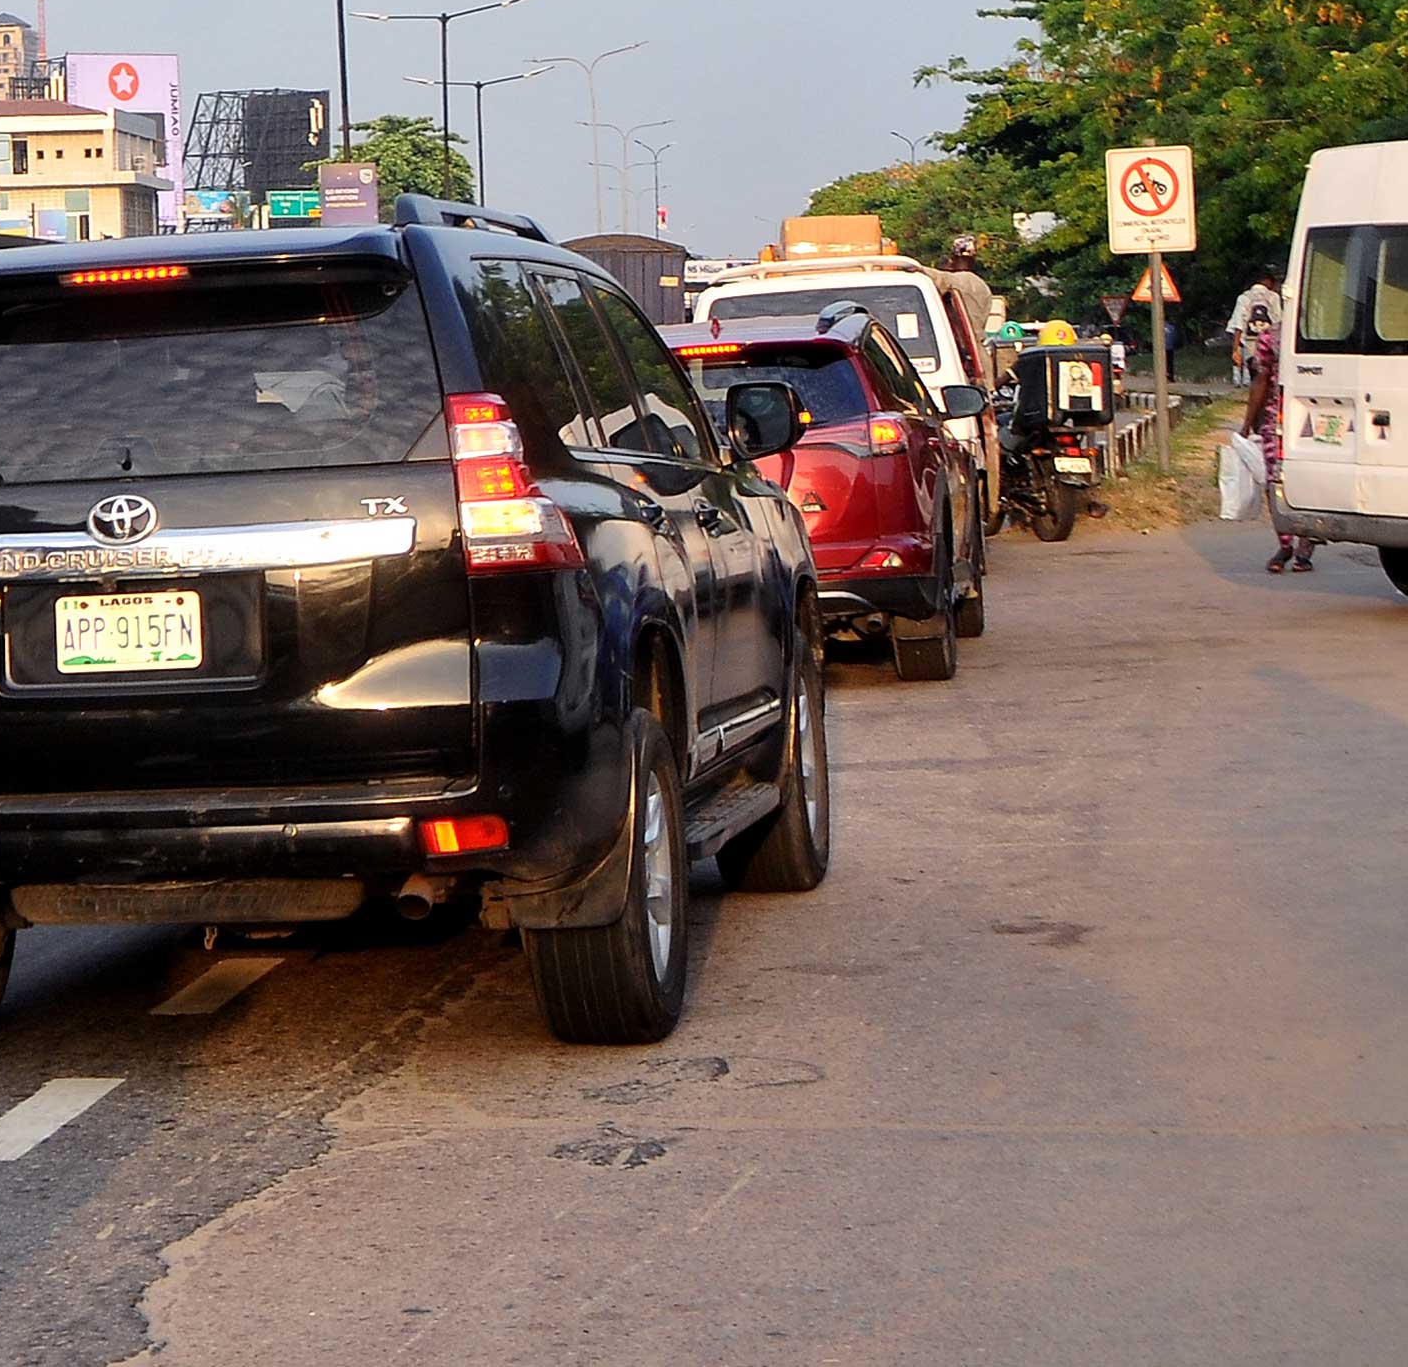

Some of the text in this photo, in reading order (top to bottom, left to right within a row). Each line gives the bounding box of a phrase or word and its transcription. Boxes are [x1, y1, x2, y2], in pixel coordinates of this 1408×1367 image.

[360, 497, 409, 515] TX
[46, 548, 176, 570] CRUISER
[100, 597, 154, 607] LAGOS
